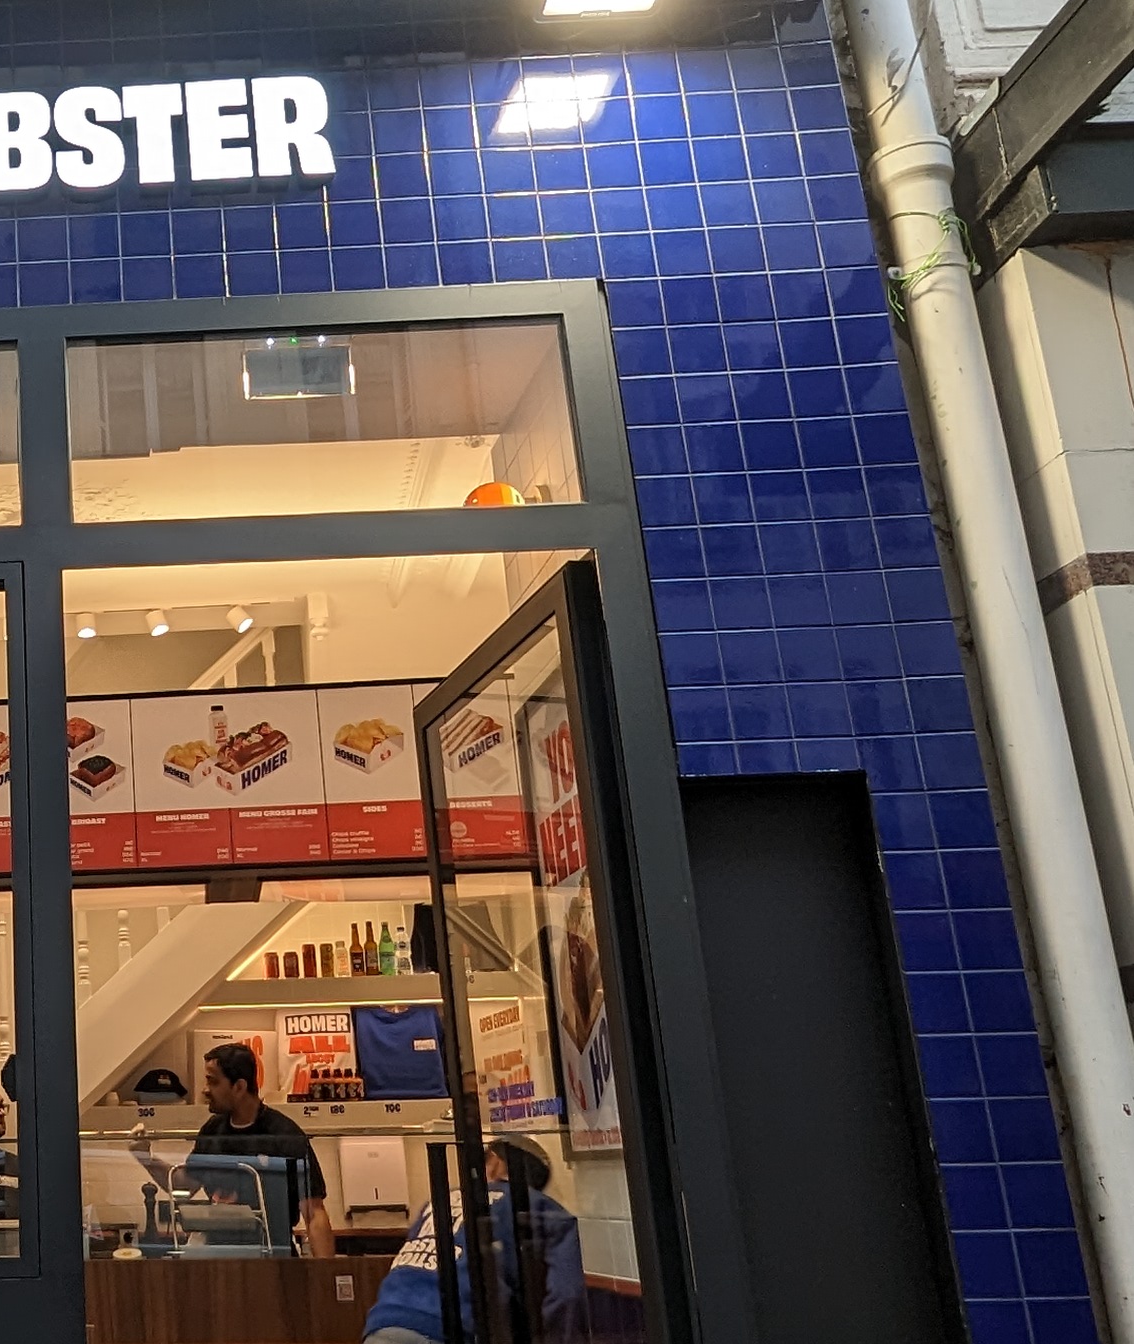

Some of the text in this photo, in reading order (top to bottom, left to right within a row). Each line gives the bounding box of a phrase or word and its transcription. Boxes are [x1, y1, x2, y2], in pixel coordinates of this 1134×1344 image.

[334, 747, 367, 769] HOMER
[240, 749, 289, 790] HOMER
[362, 805, 388, 813] SIDES
[287, 1014, 349, 1034] HOMER
[289, 1034, 351, 1054] ALL
